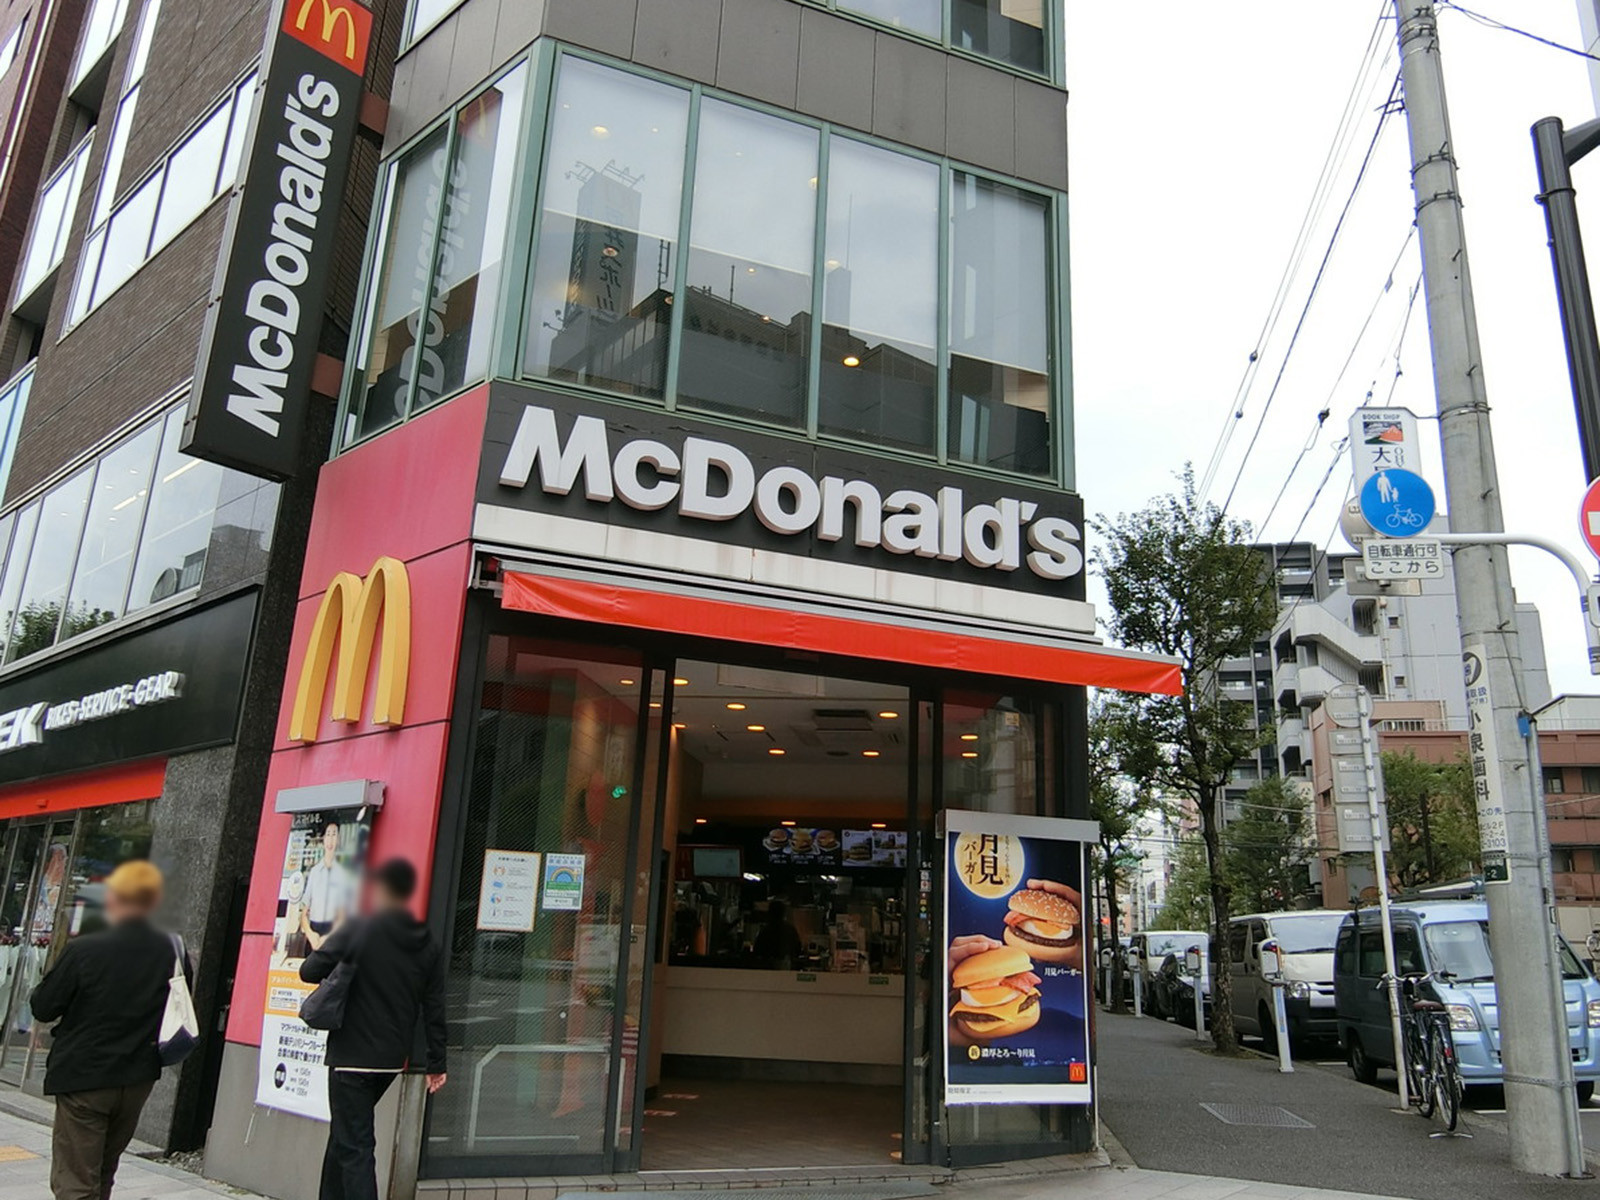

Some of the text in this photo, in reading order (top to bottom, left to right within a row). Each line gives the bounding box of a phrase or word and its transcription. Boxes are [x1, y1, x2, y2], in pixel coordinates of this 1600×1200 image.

[226, 74, 340, 438] McDonald's
[1371, 446, 1392, 471] 大
[500, 404, 1084, 580] McDonald's
[1368, 543, 1438, 558] 自転車通行可
[1371, 560, 1440, 574] ここから
[963, 841, 978, 885] バーガー
[977, 833, 1004, 885] 月見
